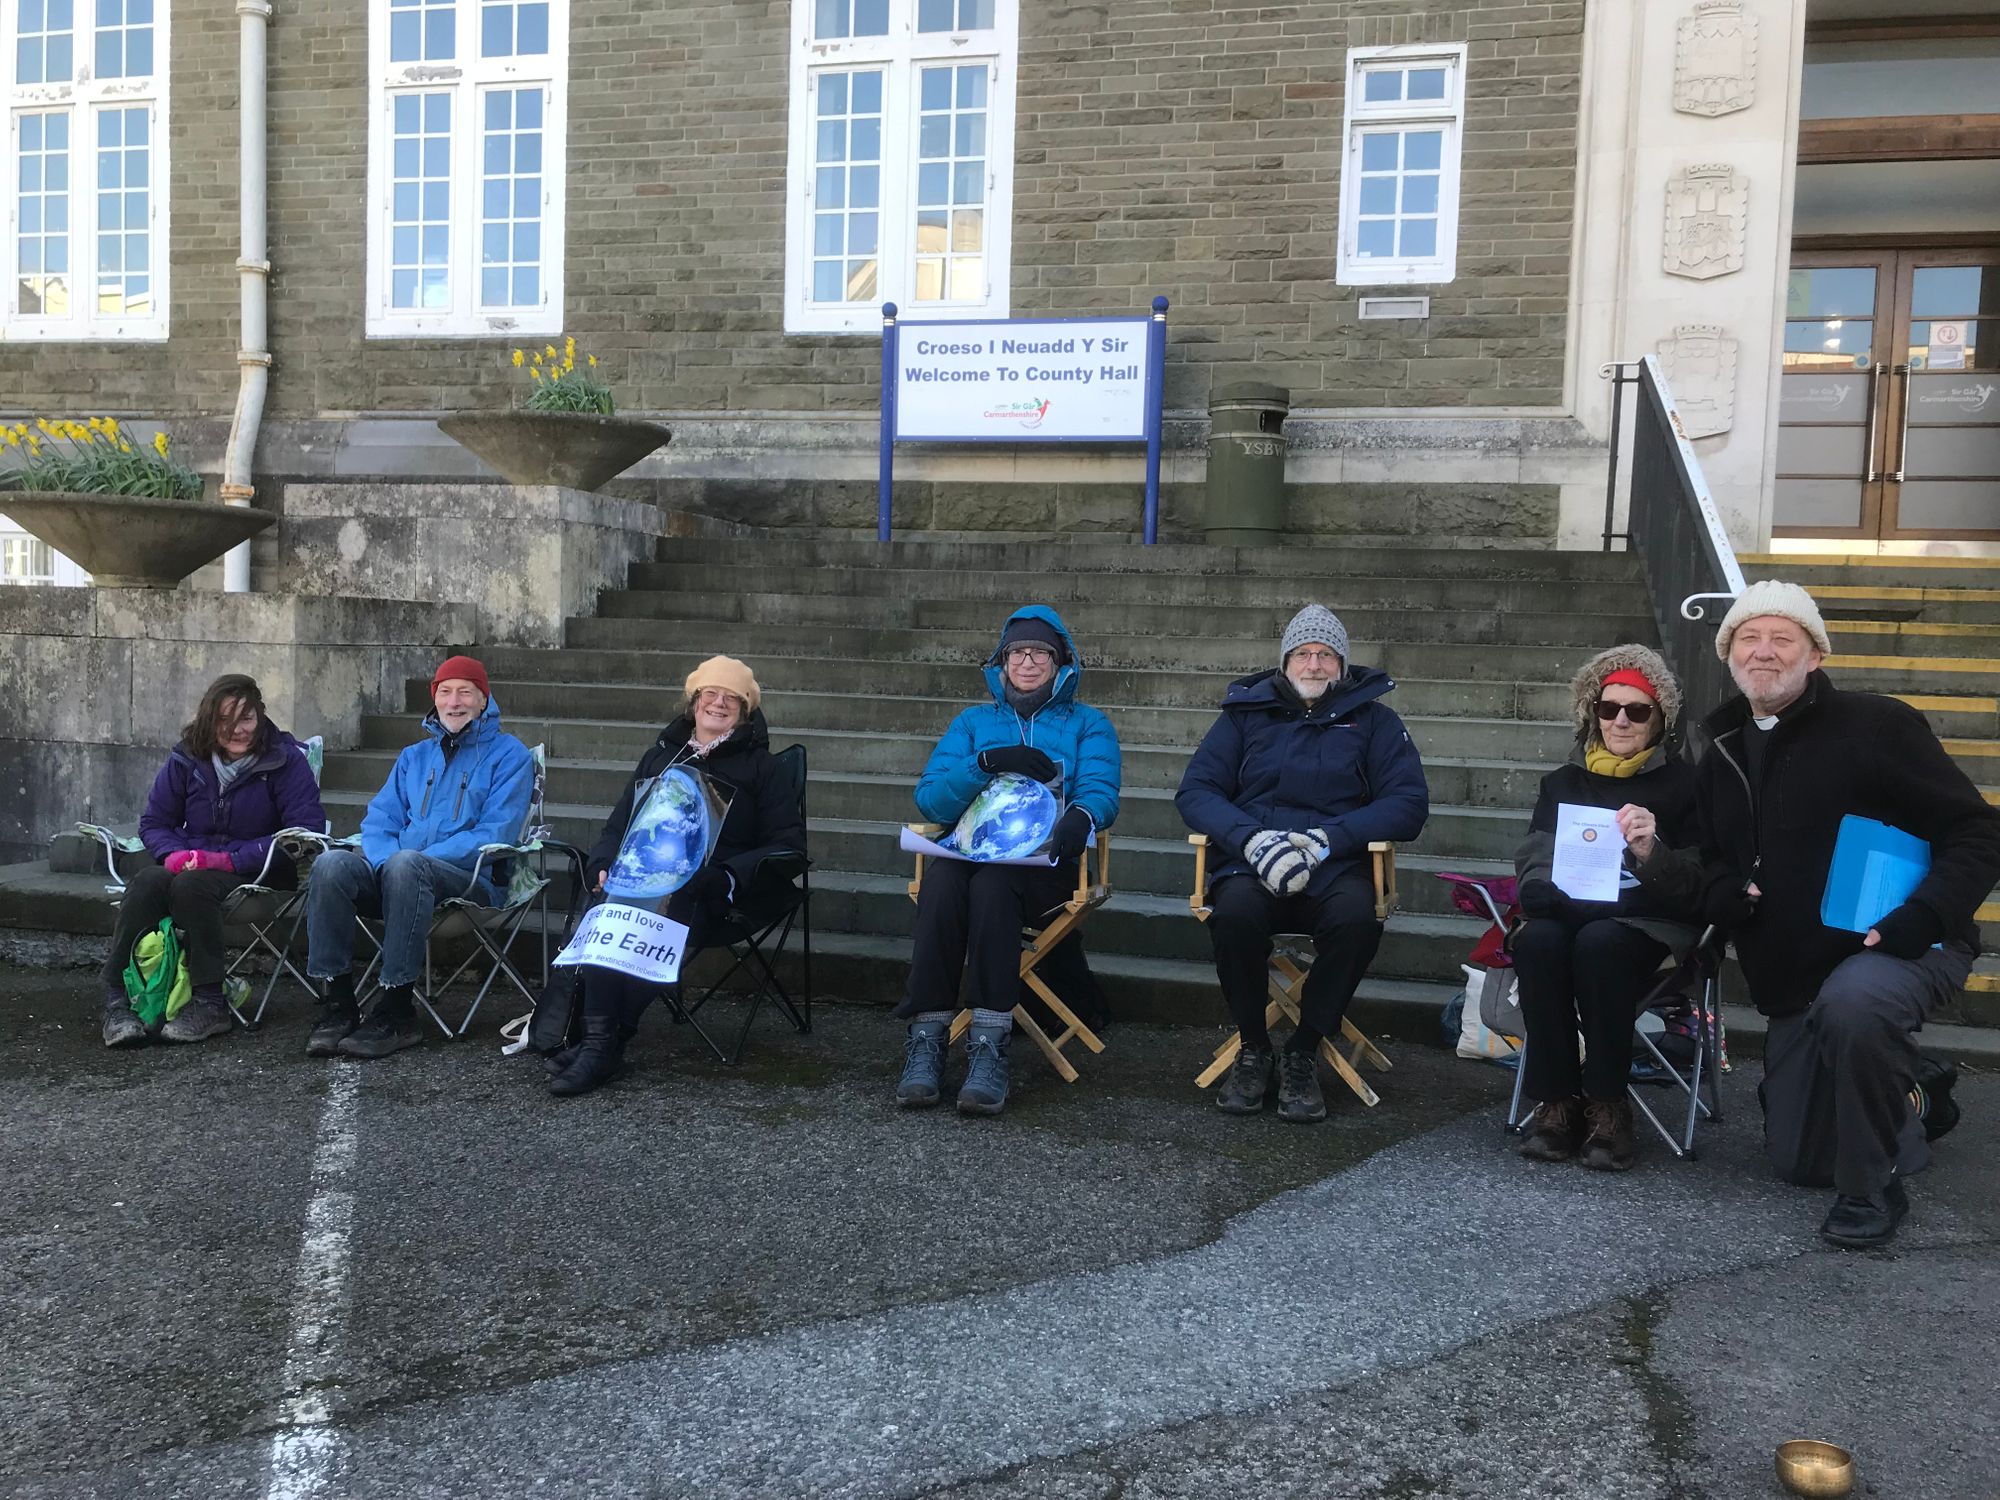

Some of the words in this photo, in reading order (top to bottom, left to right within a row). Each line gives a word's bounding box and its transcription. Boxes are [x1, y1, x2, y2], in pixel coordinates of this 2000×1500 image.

[917, 340, 982, 355] Croeso
[989, 340, 995, 354] I
[1001, 339, 1075, 354] Neuadd
[1082, 338, 1095, 352] Y
[1101, 338, 1129, 352] Sir
[905, 367, 990, 382] Welcome
[997, 367, 1019, 381] To
[1025, 366, 1093, 384] County
[1100, 365, 1138, 380] Hall
[983, 410, 1039, 418] Carmarthenshire
[1011, 402, 1021, 410] Sir
[606, 909, 632, 921] and
[635, 912, 664, 932] love
[584, 926, 613, 945] the
[619, 932, 677, 965] Earth
